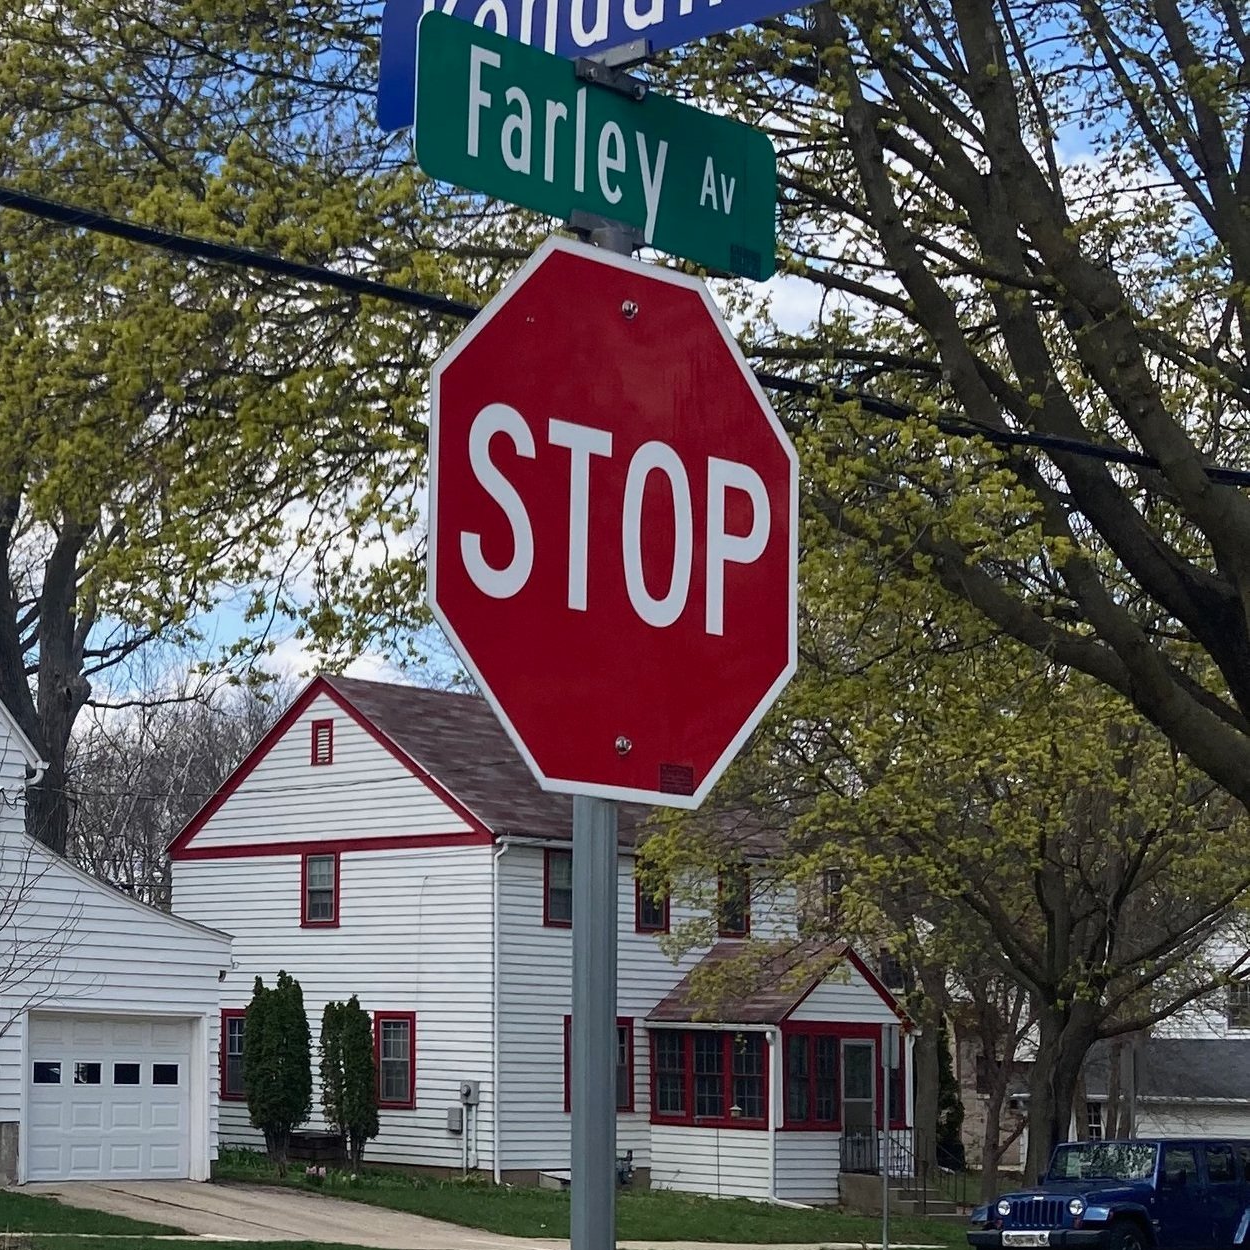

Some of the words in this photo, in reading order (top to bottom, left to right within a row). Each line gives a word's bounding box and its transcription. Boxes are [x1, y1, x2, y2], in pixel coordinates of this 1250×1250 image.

[467, 44, 669, 245] Farley
[699, 156, 736, 215] Av
[460, 402, 771, 637] STOP
